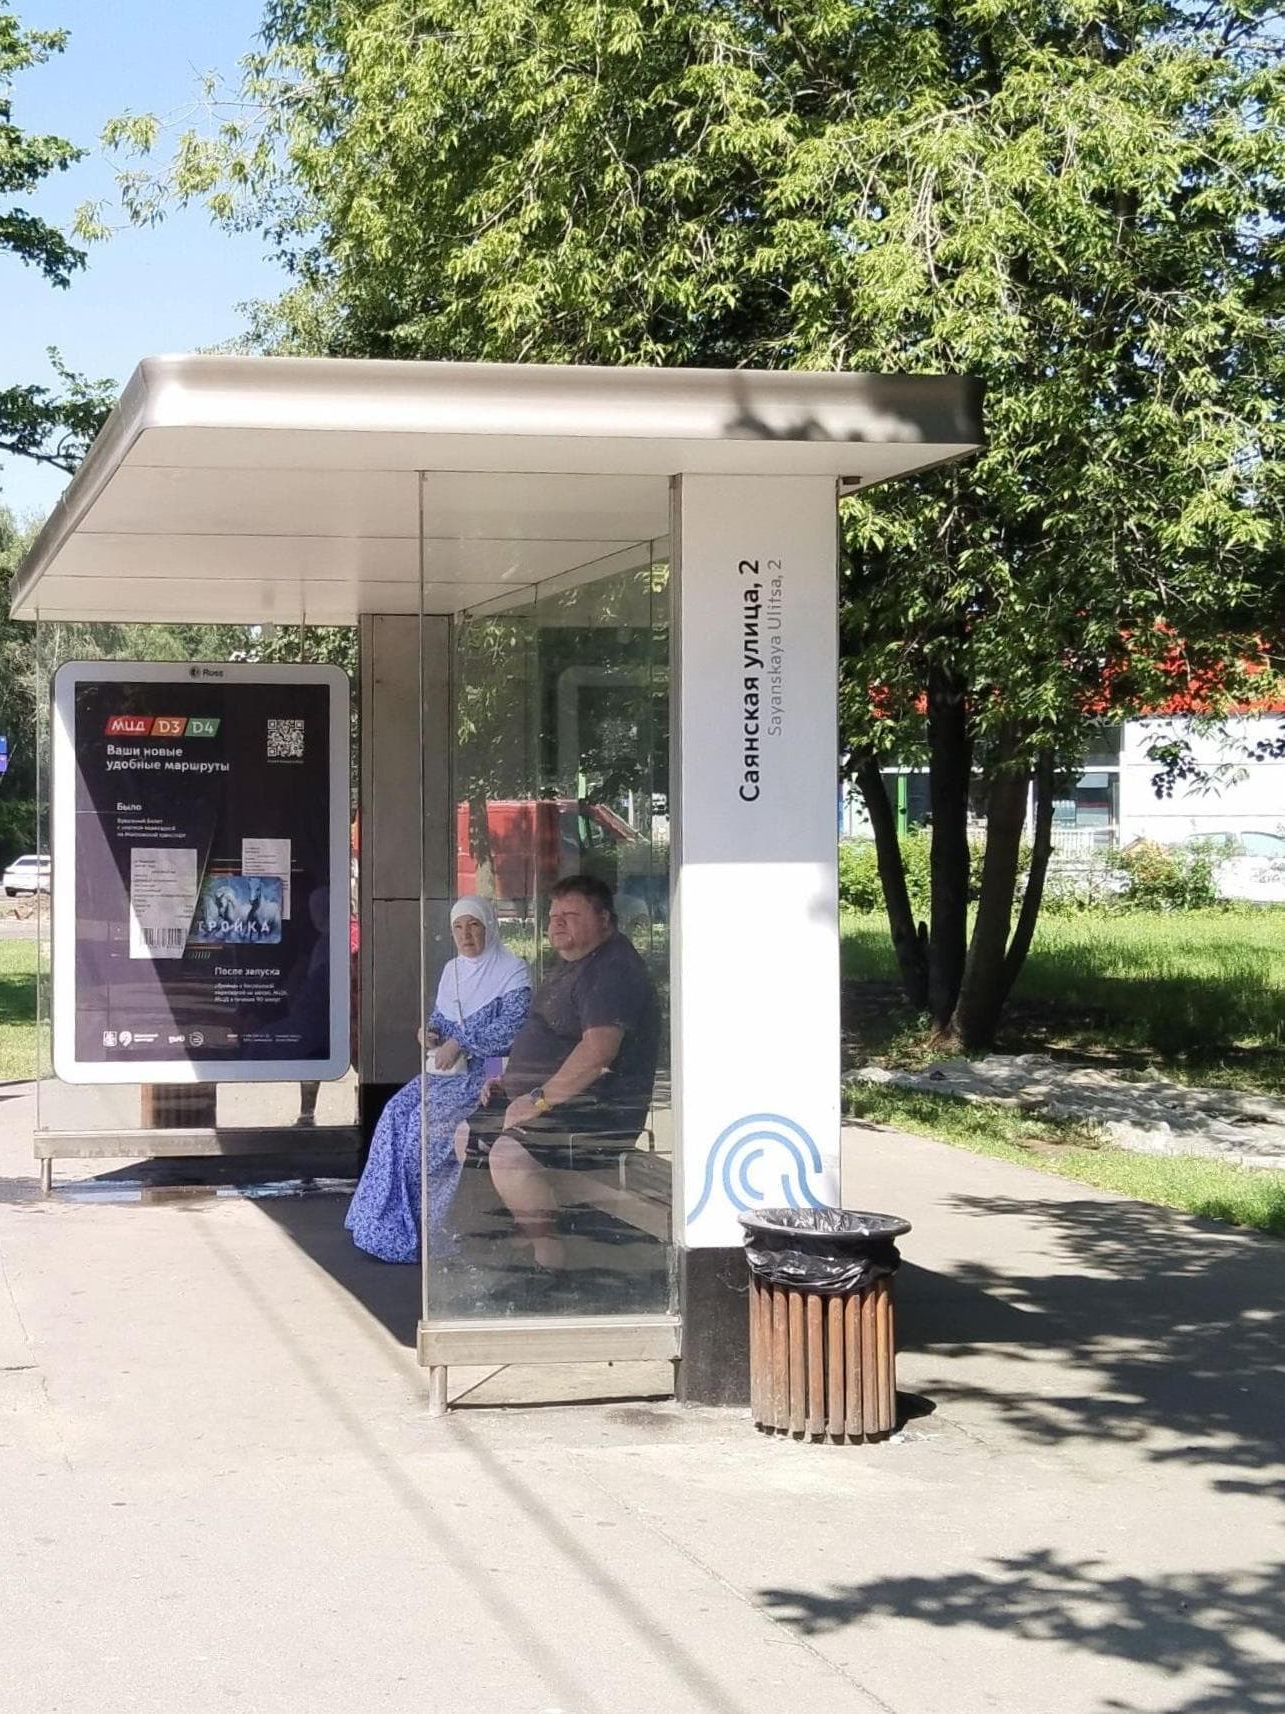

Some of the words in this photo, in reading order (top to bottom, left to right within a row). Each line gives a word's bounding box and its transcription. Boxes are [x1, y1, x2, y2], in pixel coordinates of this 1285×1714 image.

[737, 559, 760, 575] 2
[767, 558, 782, 570] 2
[767, 574, 785, 630] Ulitsa,
[741, 582, 765, 670] улица,
[766, 635, 787, 737] Sayanskaya
[158, 720, 181, 733] D3
[192, 721, 215, 734] D4
[737, 676, 761, 803] Саянская
[106, 744, 141, 757] Ваши
[144, 746, 183, 758] новые
[106, 759, 161, 772] удобные
[164, 760, 230, 774] маршруты
[116, 801, 142, 812] Было
[196, 917, 271, 932] ТРОЙКА
[214, 966, 243, 976] После
[245, 968, 281, 978] запуска
